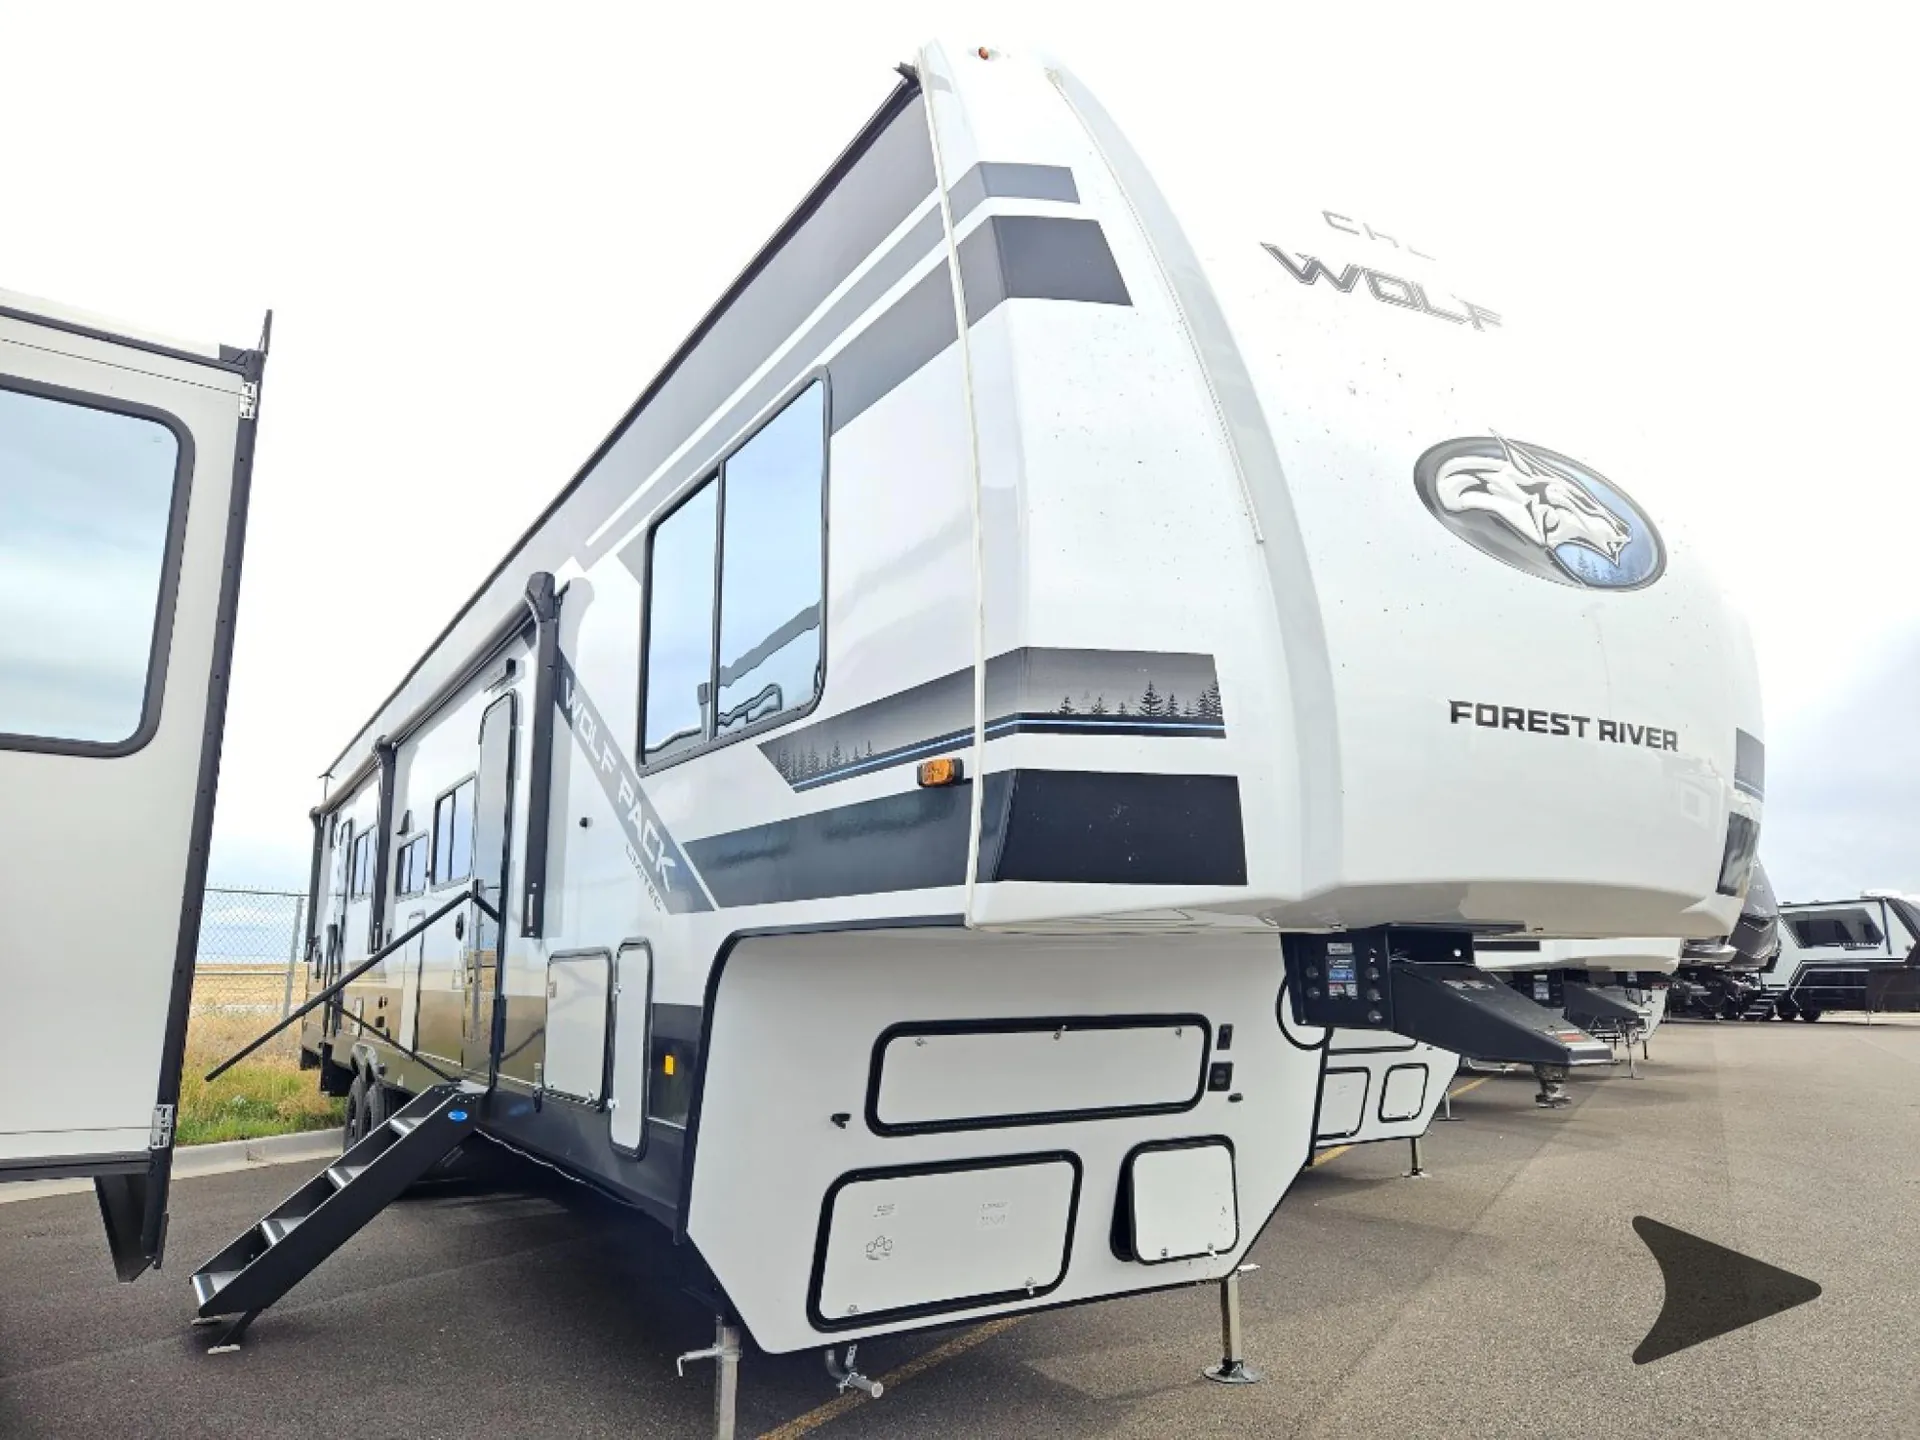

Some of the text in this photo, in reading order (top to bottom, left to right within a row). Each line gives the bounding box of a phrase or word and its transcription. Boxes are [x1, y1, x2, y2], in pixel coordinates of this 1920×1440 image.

[1260, 241, 1502, 333] WOLF
[1448, 700, 1679, 752] FOREST RIVER
[565, 677, 617, 773] WOLF
[618, 768, 676, 892] PACK
